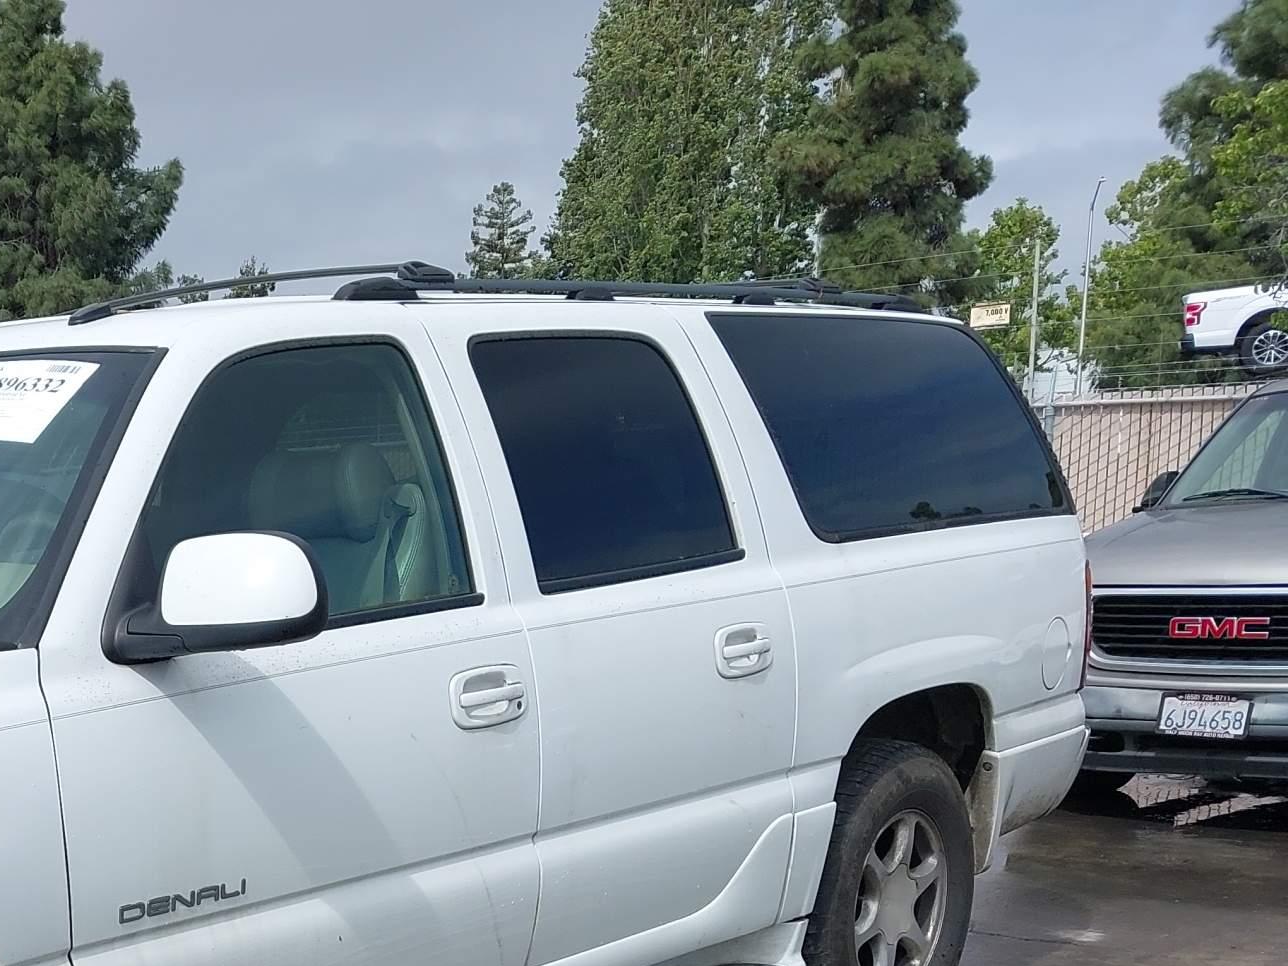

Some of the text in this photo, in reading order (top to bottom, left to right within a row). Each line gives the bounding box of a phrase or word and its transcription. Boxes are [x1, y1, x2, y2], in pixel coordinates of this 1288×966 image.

[1168, 616, 1271, 640] GMC
[1164, 709, 1244, 731] 6J94658
[118, 877, 247, 925] DENALI
